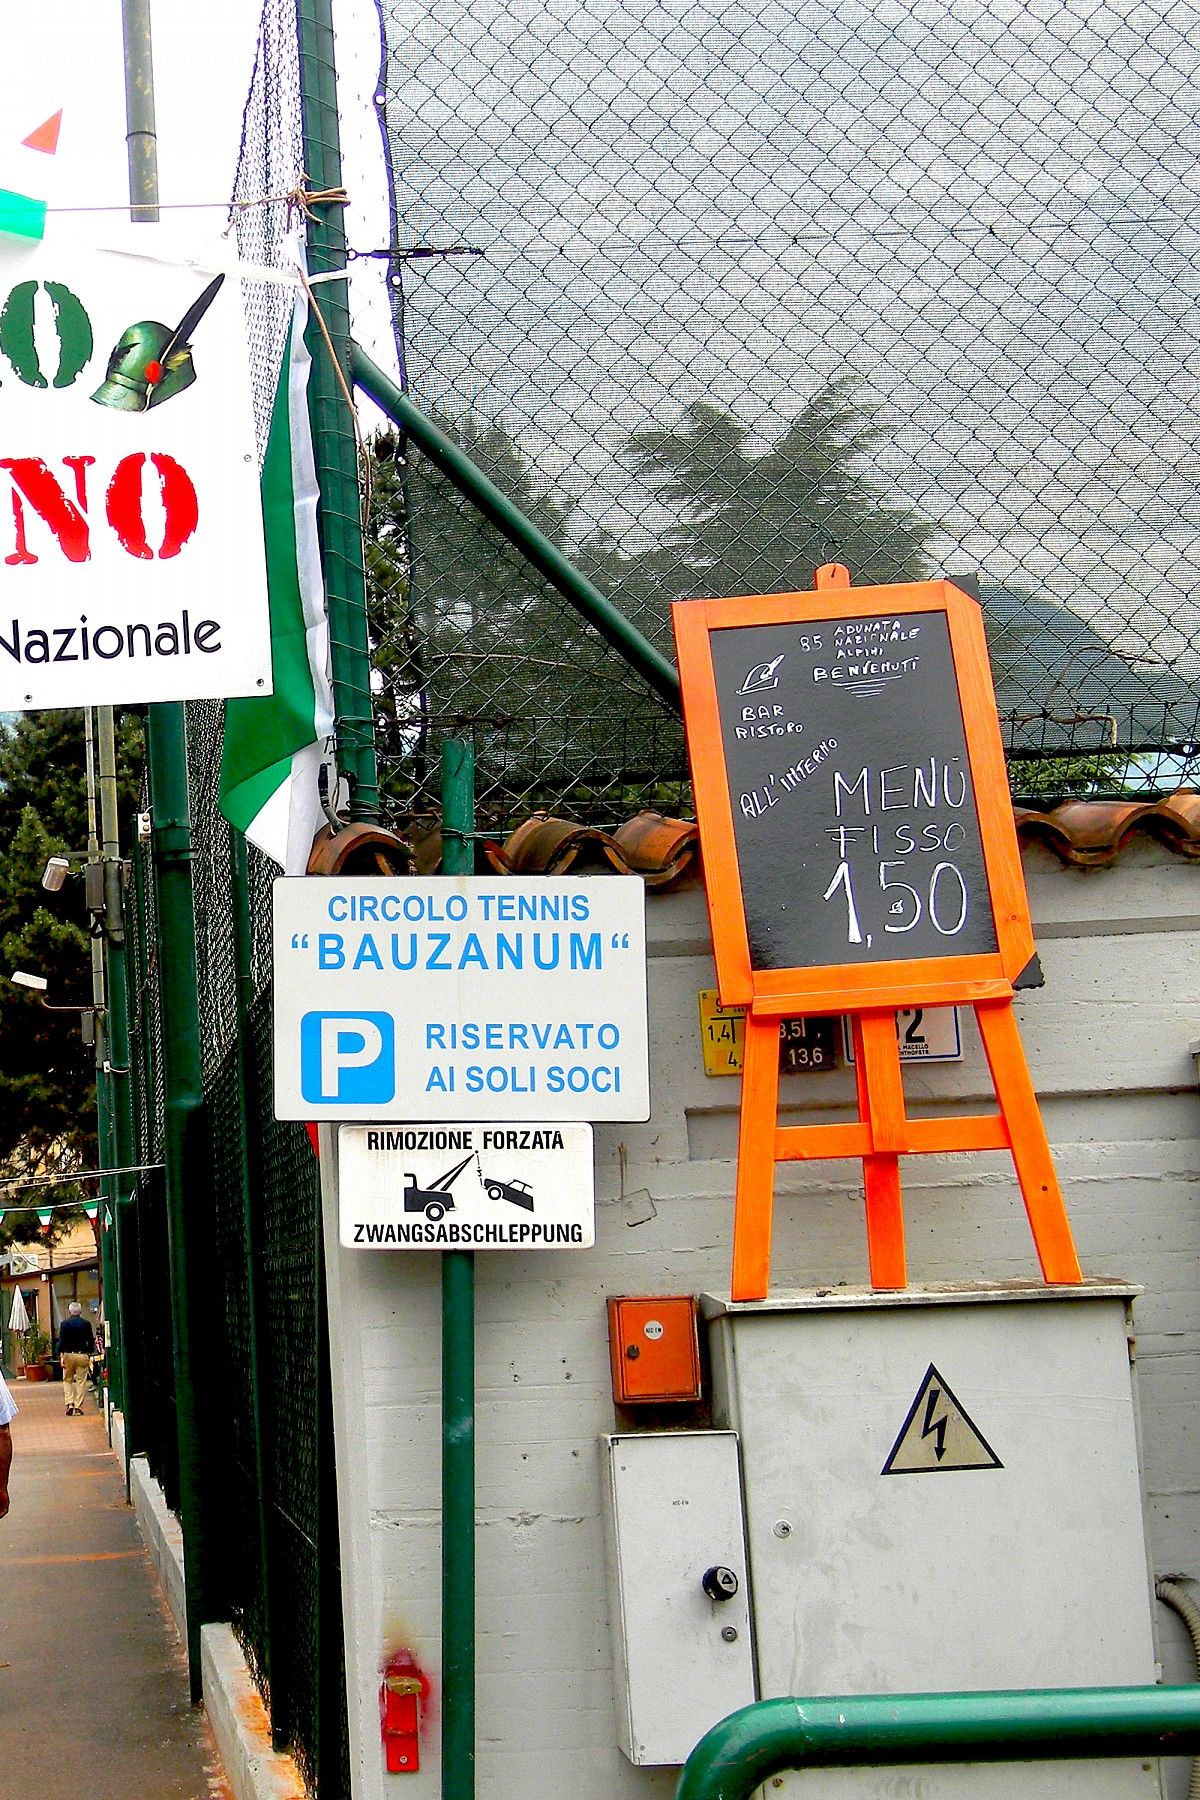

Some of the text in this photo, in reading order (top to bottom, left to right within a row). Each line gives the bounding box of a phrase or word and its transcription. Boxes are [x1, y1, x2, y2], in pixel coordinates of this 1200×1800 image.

[800, 620, 901, 651] 85 ADUNATA
[741, 705, 784, 721] BAR
[735, 721, 804, 739] RISTORO
[824, 823, 966, 858] FISSO
[328, 895, 590, 922] CIRCOLO TENNIS
[822, 861, 967, 950] 1,50
[426, 1023, 620, 1050] RISERVATO
[321, 1018, 383, 1097] P
[789, 1047, 823, 1066] 13,6
[425, 1066, 620, 1093] AI SOLI SOCI
[367, 1131, 564, 1150] RIMOZIONE FORZATA
[353, 1224, 583, 1243] ZWANGSABSCHLEPPUNG
